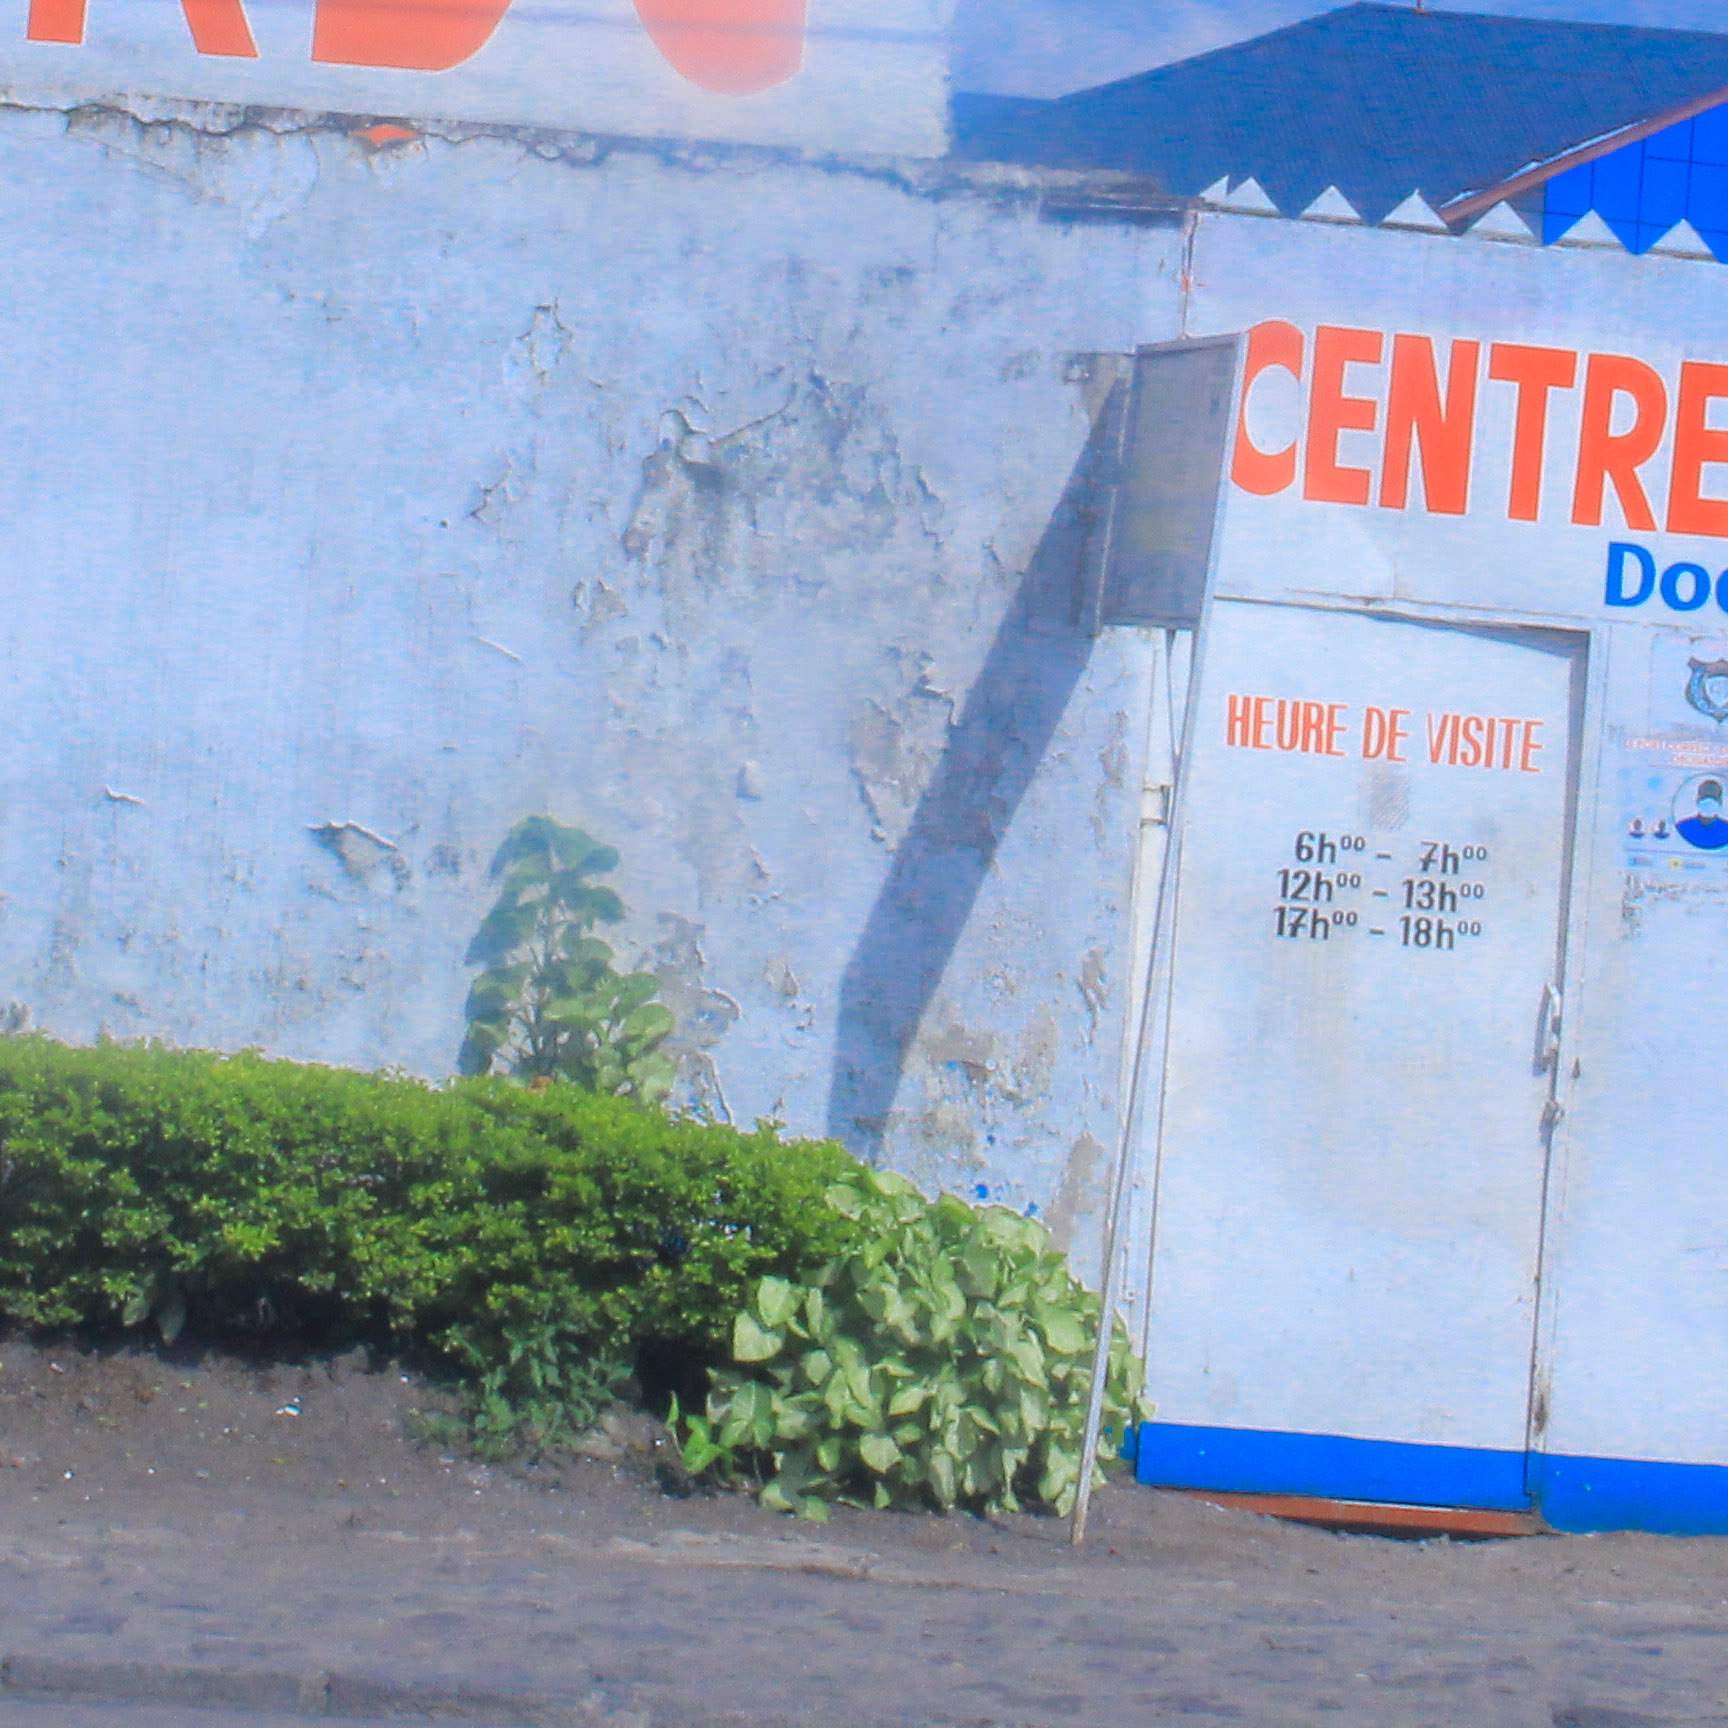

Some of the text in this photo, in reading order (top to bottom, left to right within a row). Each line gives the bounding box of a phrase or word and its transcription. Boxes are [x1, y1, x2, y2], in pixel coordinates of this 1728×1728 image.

[1226, 693, 1545, 773] HEURE DE VISITE
